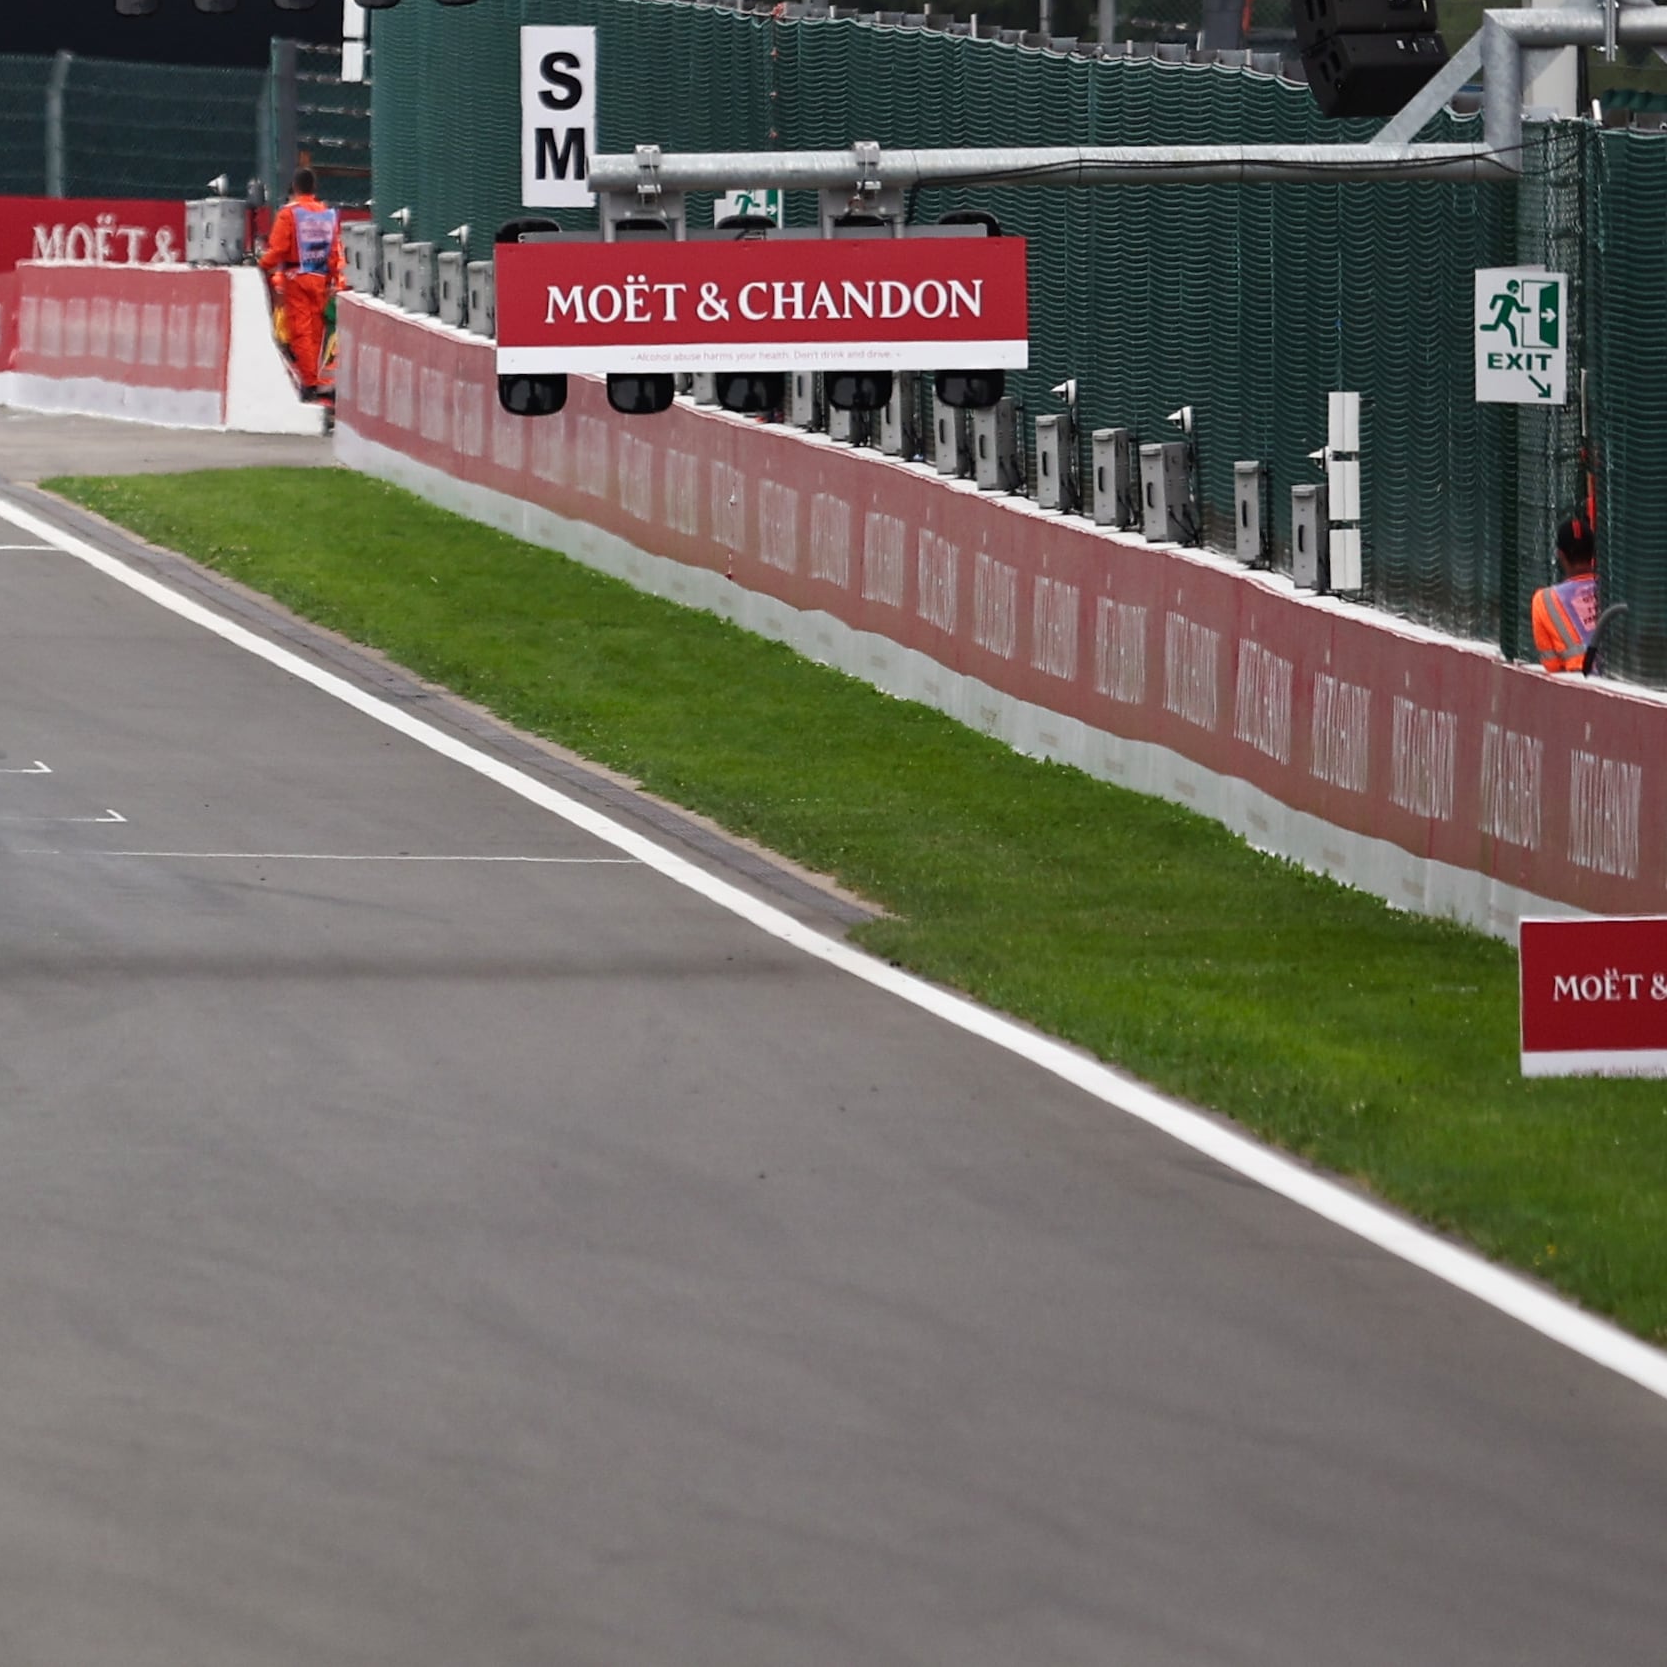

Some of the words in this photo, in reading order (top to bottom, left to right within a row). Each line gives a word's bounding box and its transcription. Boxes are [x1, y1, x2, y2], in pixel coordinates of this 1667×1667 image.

[544, 275, 686, 323] MOËT
[696, 282, 730, 322] &
[737, 279, 983, 320] CHANDON
[1488, 352, 1552, 371] EXIT
[1553, 967, 1643, 1002] MOËT
[1651, 972, 1667, 1000] &
